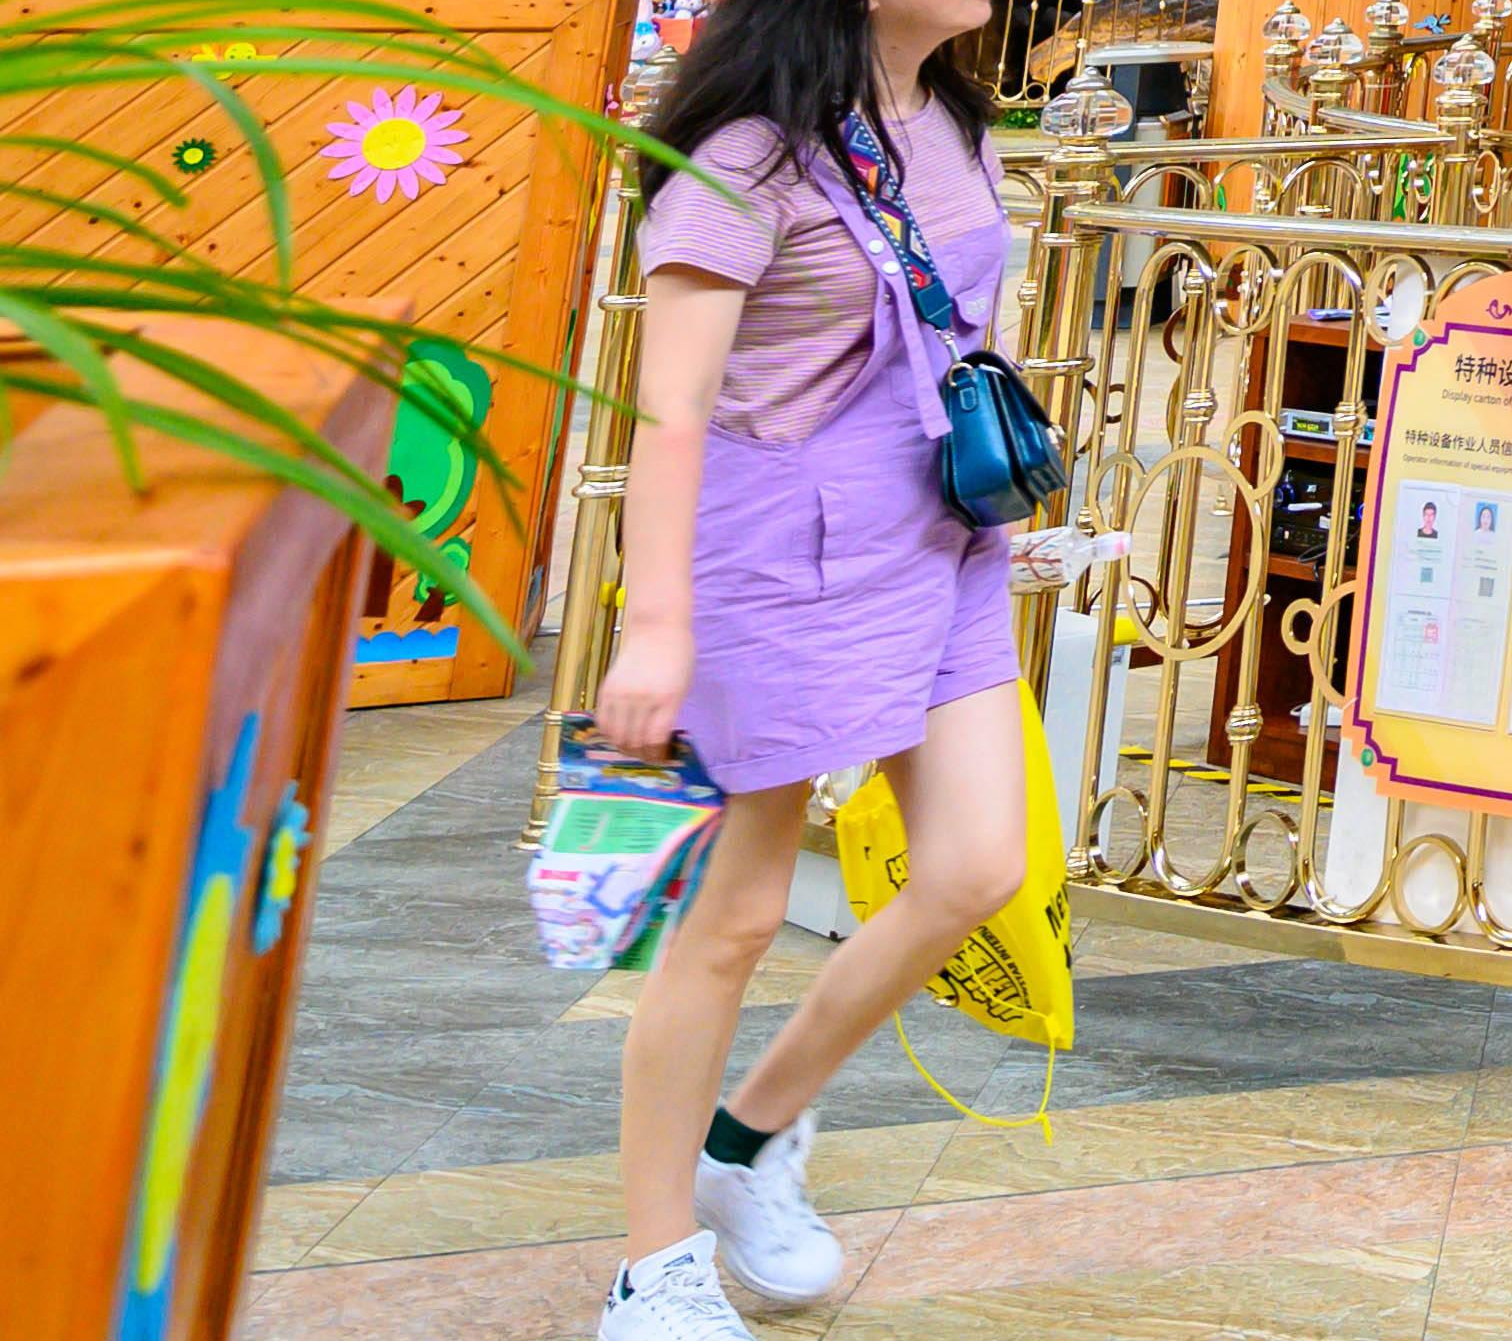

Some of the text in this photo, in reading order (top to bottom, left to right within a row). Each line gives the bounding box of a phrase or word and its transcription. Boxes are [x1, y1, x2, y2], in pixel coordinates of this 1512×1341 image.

[1442, 389, 1472, 404] Display
[1473, 394, 1501, 405] carton
[1503, 395, 1512, 406] of
